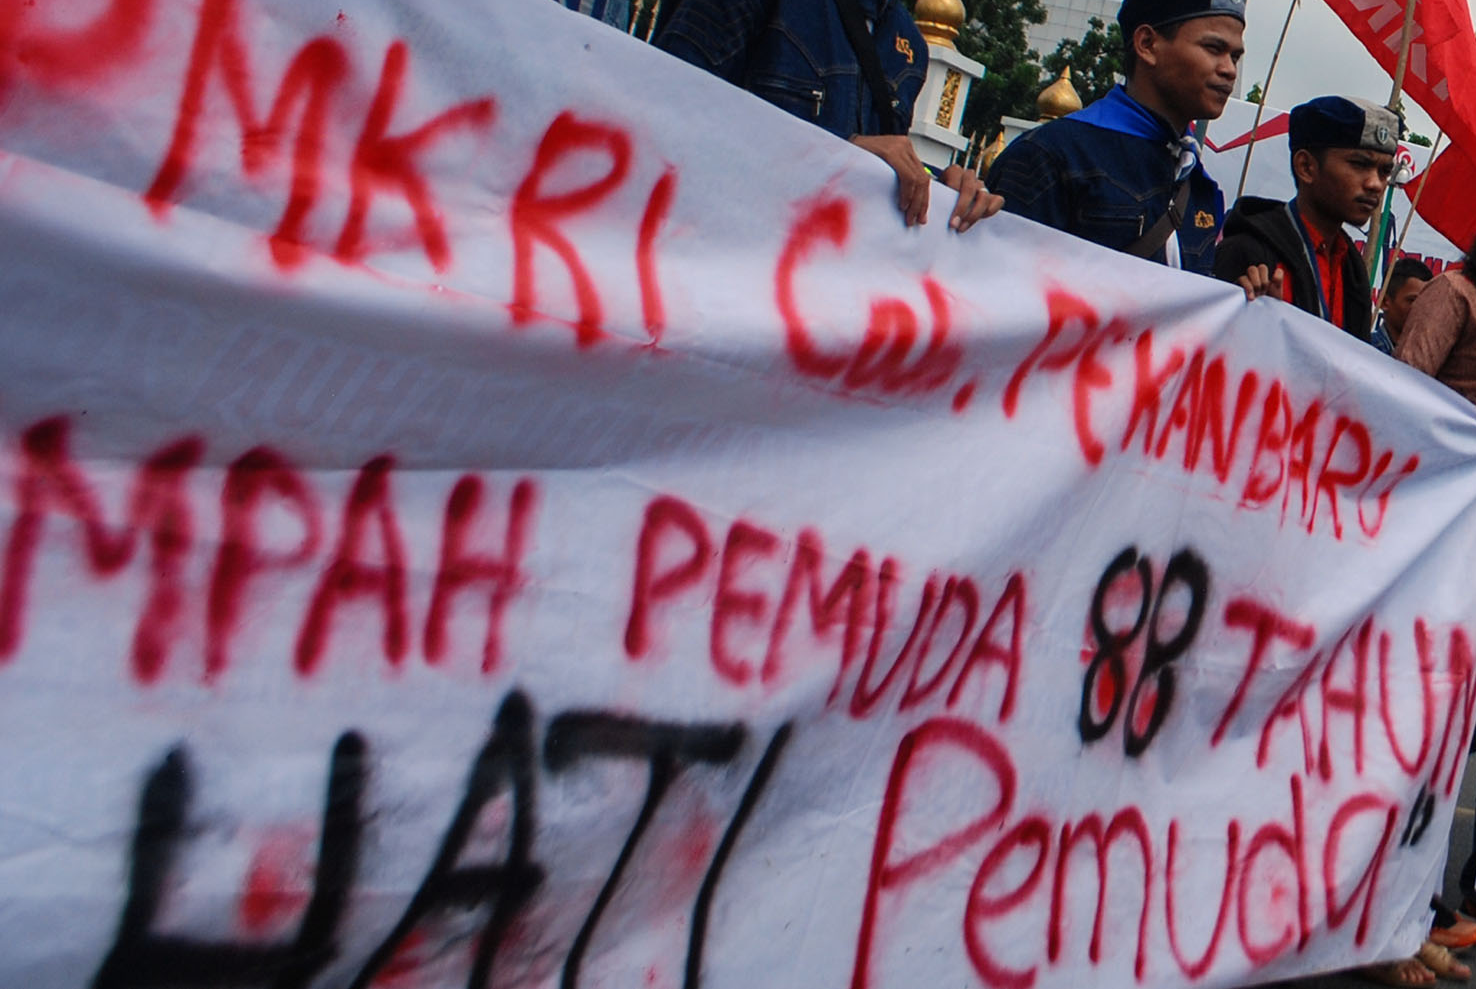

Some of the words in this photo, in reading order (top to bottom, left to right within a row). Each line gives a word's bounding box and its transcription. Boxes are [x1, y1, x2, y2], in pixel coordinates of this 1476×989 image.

[1003, 282, 1420, 540] PEKANBARU
[624, 495, 1030, 722] PEMUDA
[1077, 544, 1210, 758] 88
